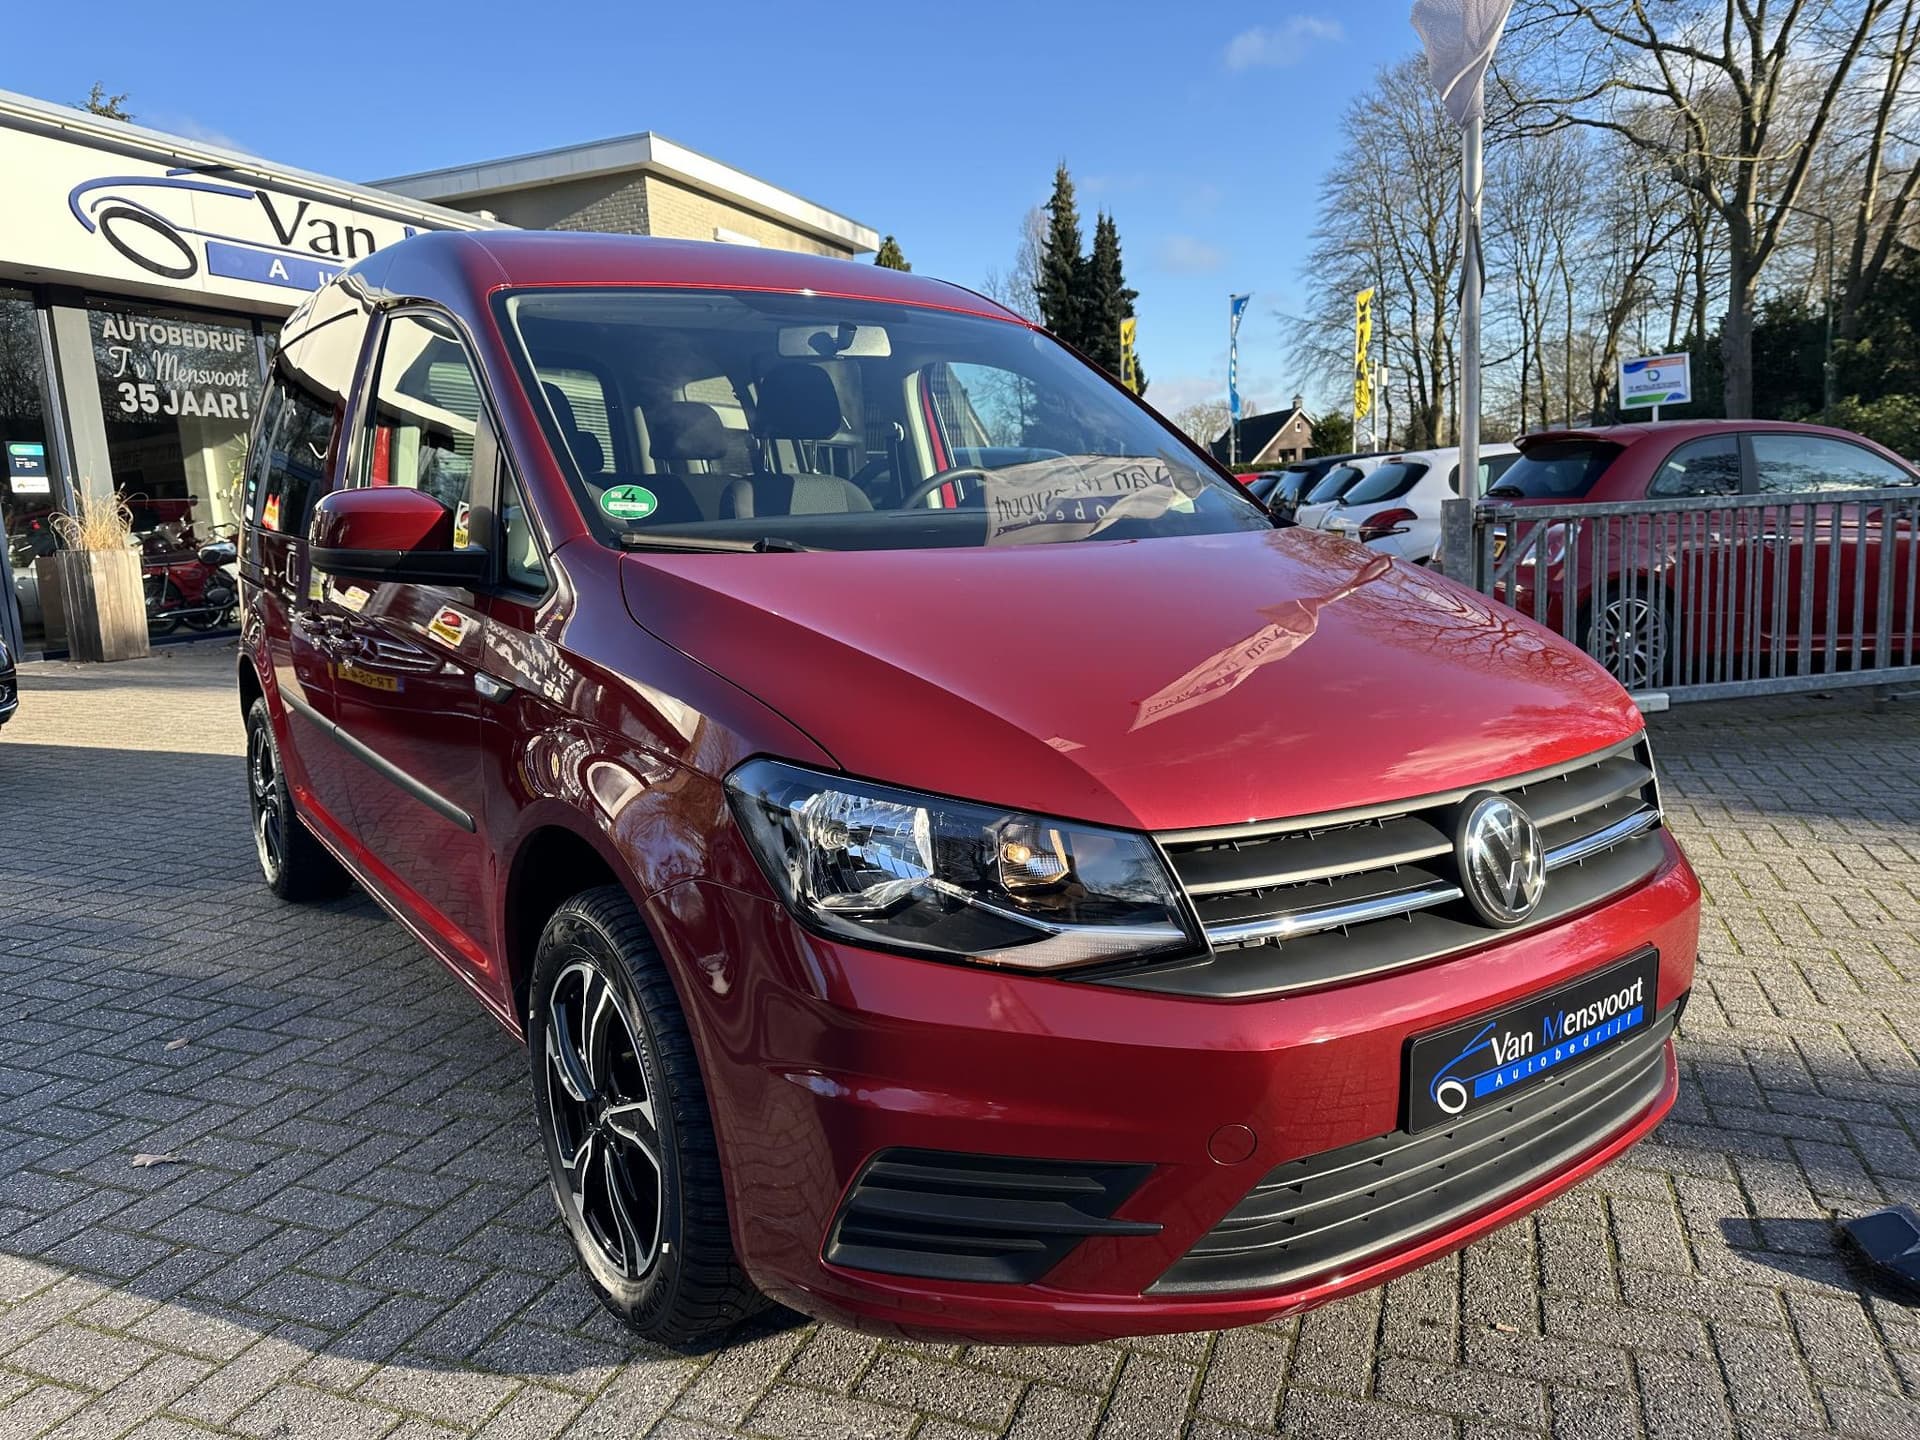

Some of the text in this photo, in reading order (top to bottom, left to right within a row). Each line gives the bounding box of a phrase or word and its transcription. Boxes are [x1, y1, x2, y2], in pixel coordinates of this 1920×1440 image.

[255, 189, 376, 259] Van
[102, 318, 246, 353] AUTOBEDRIJF
[152, 349, 249, 388] Mensvoort
[118, 382, 250, 420] 35 JAAR!
[621, 487, 638, 502] 4
[1490, 976, 1644, 1066] Van Mensvoort
[1495, 1012, 1632, 1087] Autobedrijf
